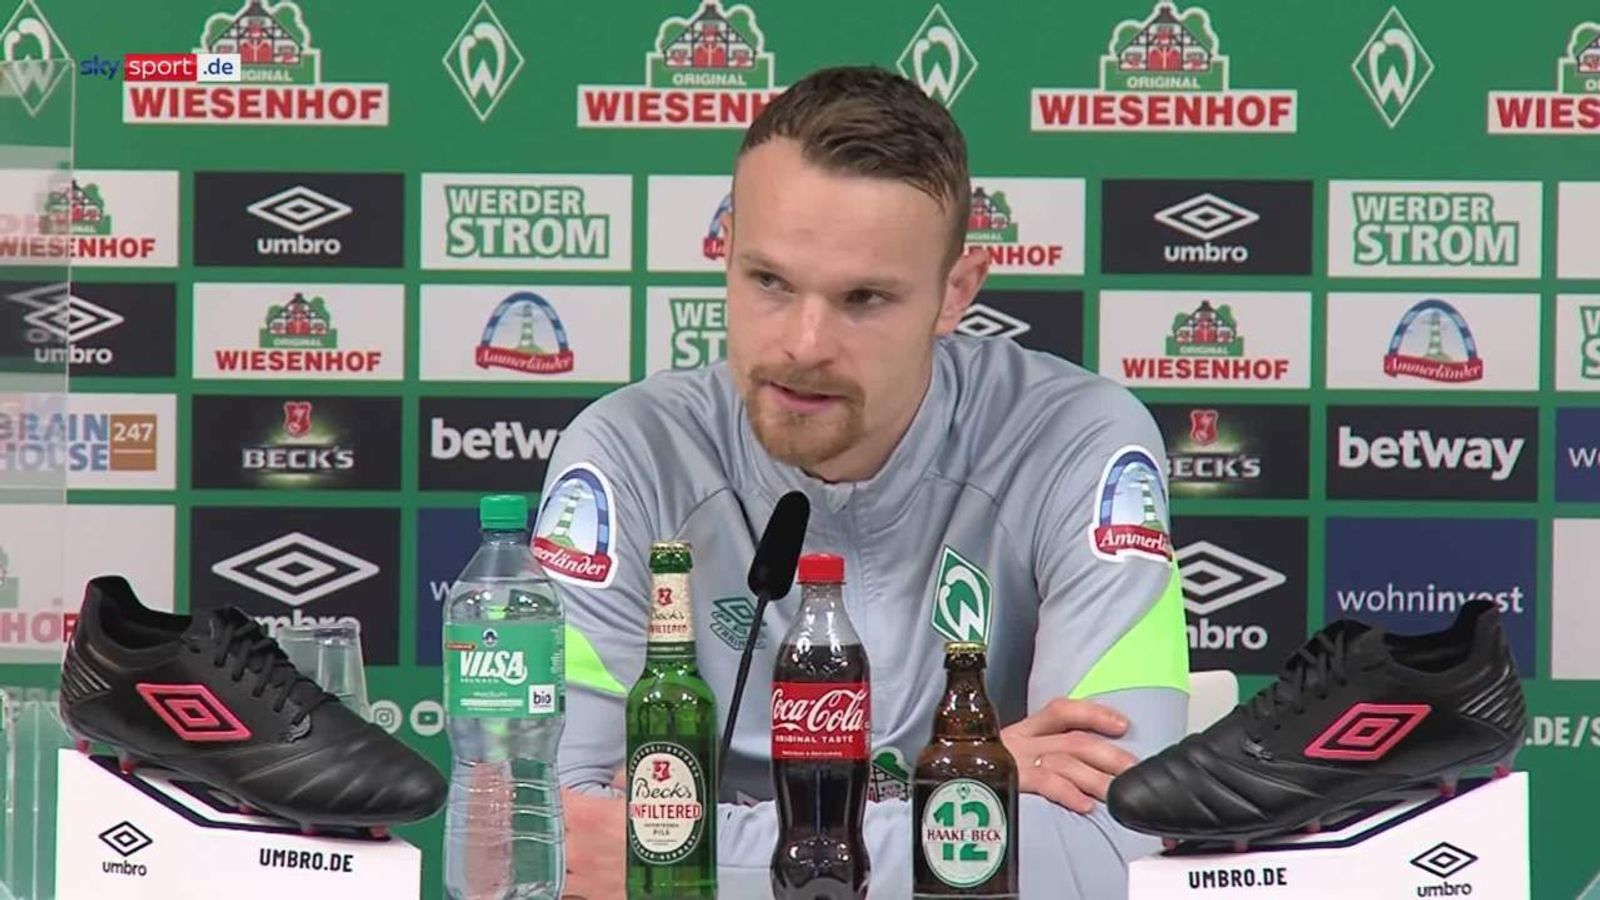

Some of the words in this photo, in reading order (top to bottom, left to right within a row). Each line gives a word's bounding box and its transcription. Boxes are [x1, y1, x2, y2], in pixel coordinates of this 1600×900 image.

[673, 73, 746, 86] ORIGINAL
[1127, 76, 1201, 89] ORIGINAL
[130, 88, 383, 119] WIESENHOF
[1038, 94, 1292, 126] WIESENHOF
[448, 188, 582, 216] WERDER
[1355, 195, 1491, 222] WERDER
[256, 235, 341, 255] umbro
[448, 216, 607, 257] STROM
[1356, 223, 1517, 264] STROM
[1163, 243, 1248, 263] umbro
[216, 351, 381, 371] WIESENHOF
[1122, 358, 1289, 380] WIESENHOF
[1386, 357, 1481, 380] Ammerländer
[113, 422, 153, 442] 247
[242, 447, 354, 470] BECK'S
[1338, 425, 1525, 481] betway
[1167, 454, 1261, 478] ECK'S
[460, 650, 528, 685] VILSA
[533, 690, 552, 705] bio
[771, 688, 868, 733] Coca-Cola
[822, 735, 854, 743] TASTE
[635, 777, 693, 799] Beck's
[102, 859, 148, 877] umbro
[259, 847, 353, 873] UMBRO.DE
[1188, 867, 1288, 890] UMBRO.DE
[1417, 881, 1473, 899] umbro
